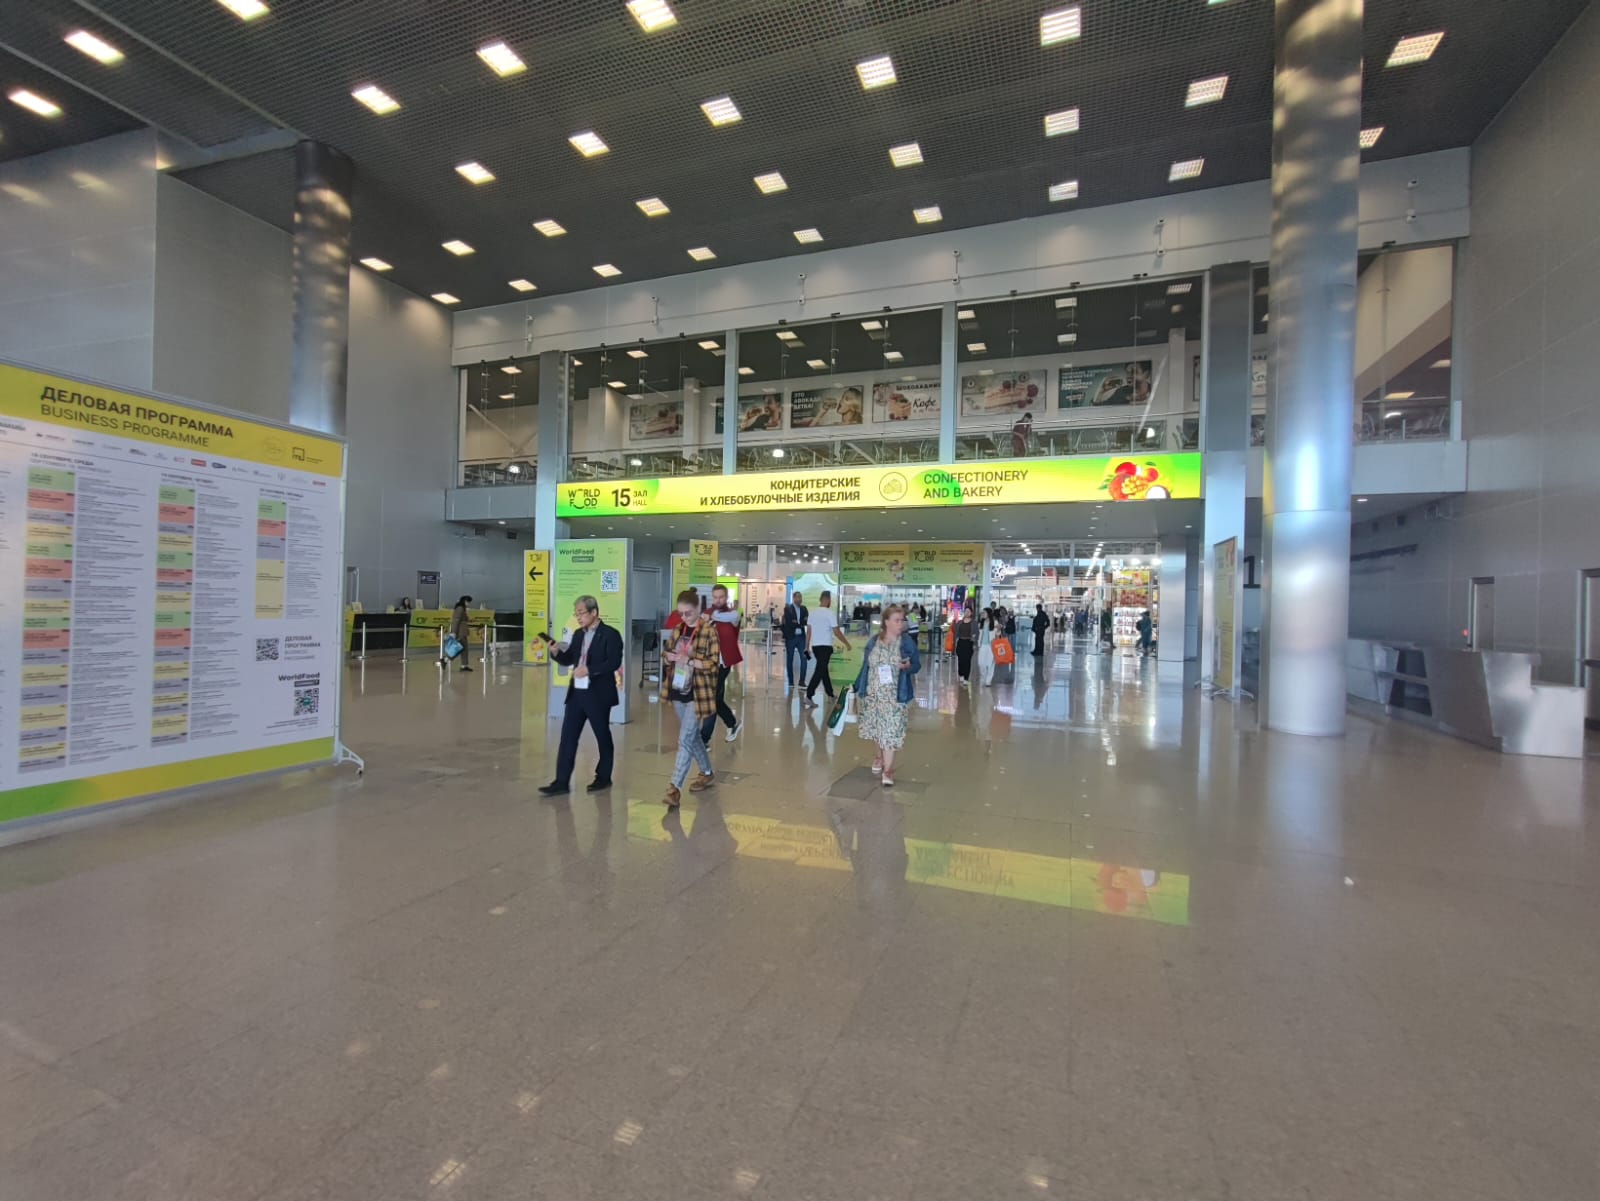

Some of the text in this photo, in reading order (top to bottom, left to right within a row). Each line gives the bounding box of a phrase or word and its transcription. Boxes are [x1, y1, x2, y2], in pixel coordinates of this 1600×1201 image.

[41, 386, 234, 438] ДЕЛОВАЯ ПРОГРАММА
[41, 404, 119, 430] BUSINESS
[123, 420, 210, 447] PROGRAMME
[770, 477, 861, 491] КОНДИТЕРСКИЕ
[924, 470, 1028, 485] CONFECTIONERY
[611, 488, 631, 507] 15
[700, 491, 861, 506] И ХЛЕБОБУЛОЧНЫЕ ИЗДЕЛИЯ
[923, 486, 1003, 499] AND BAKERY
[278, 672, 320, 681] WorldFood
